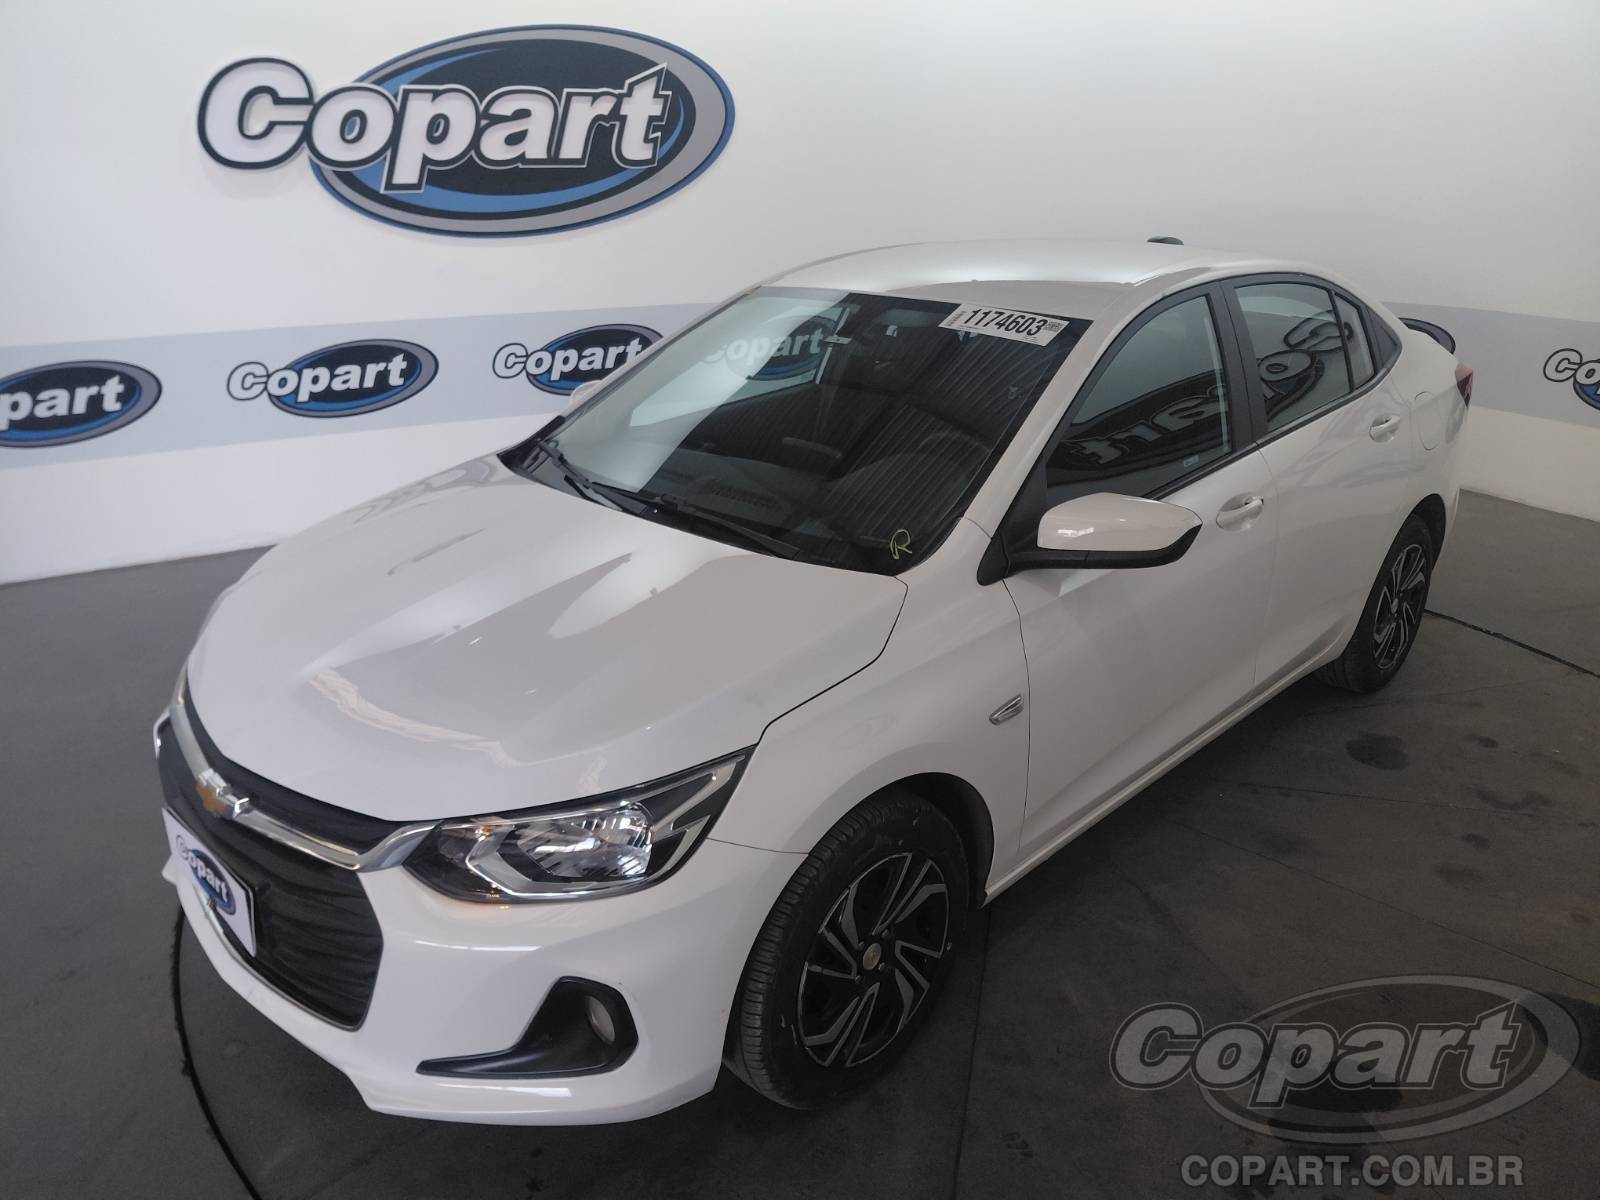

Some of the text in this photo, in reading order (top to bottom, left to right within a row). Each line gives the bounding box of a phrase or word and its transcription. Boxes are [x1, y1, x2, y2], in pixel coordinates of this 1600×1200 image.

[198, 57, 672, 193] Copart
[964, 308, 1049, 336] 1174603
[227, 353, 408, 403] Copart
[492, 337, 643, 381] Copart
[1543, 348, 1600, 396] Co
[890, 529, 913, 560] R
[176, 835, 229, 903] Copart
